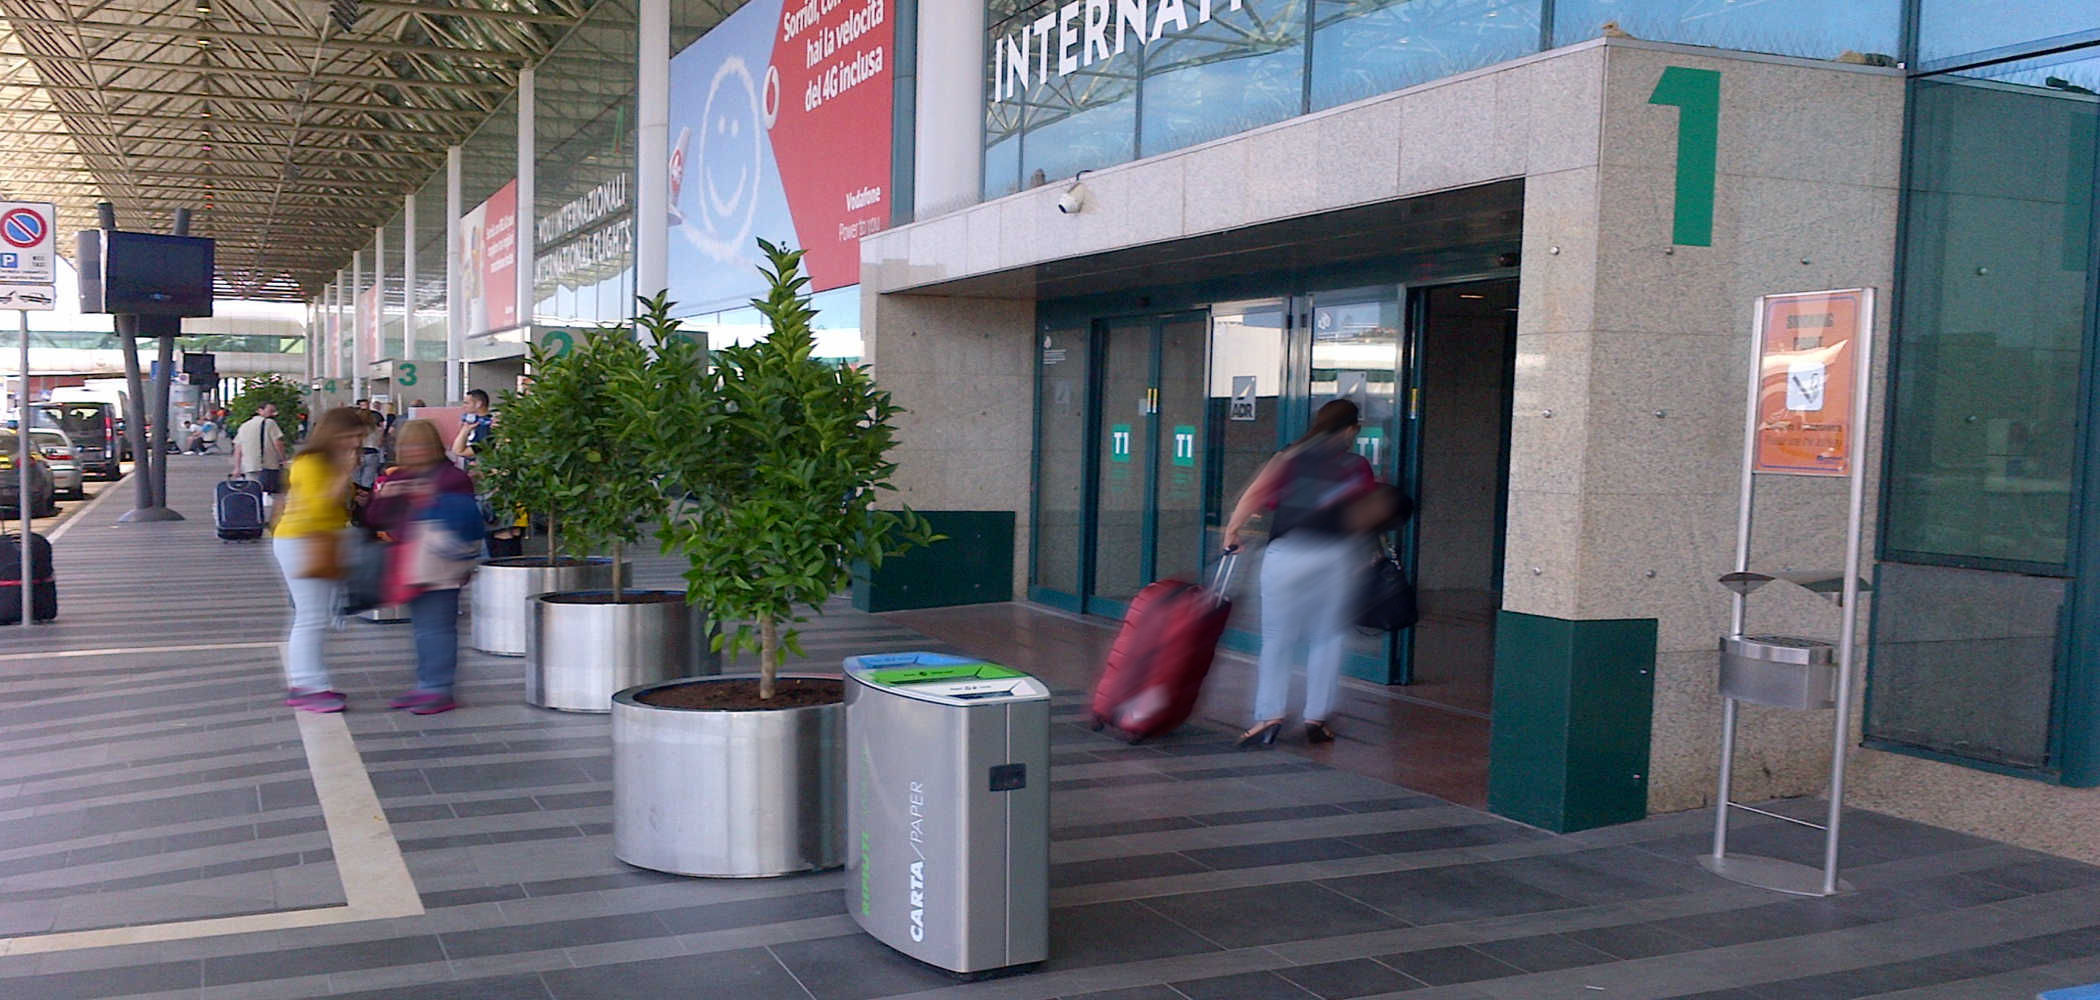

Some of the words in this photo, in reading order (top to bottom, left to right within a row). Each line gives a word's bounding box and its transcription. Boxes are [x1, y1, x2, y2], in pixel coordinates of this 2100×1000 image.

[806, 30, 823, 69] hai
[824, 27, 835, 58] la
[805, 75, 822, 112] del
[822, 65, 838, 100] 4G
[839, 46, 883, 93] inclusa
[1648, 66, 1720, 246] 1
[845, 186, 881, 211] Vodafone
[324, 379, 337, 393] 4
[397, 363, 418, 387] 3
[1232, 402, 1254, 418] ADR
[1114, 431, 1129, 455] T1
[1175, 433, 1193, 459] T1
